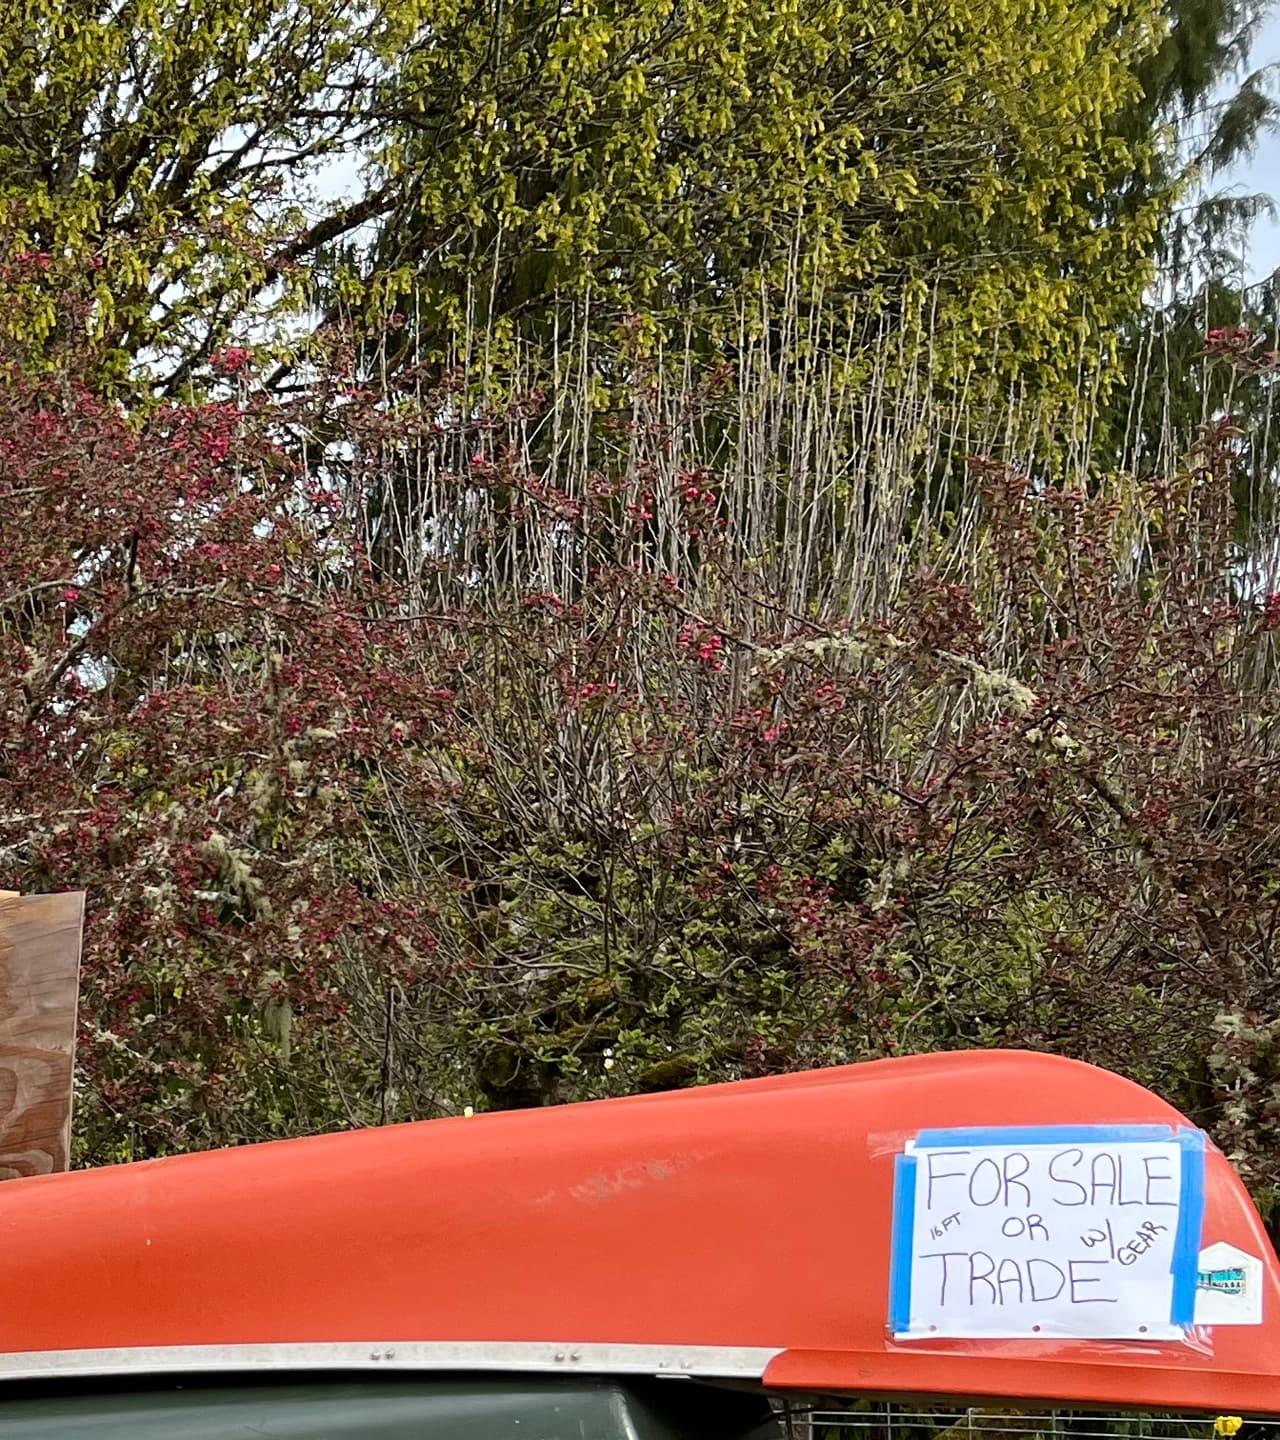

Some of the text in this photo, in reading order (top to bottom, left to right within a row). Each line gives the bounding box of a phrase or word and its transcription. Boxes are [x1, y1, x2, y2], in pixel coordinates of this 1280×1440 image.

[928, 1149, 1178, 1210] FOR SALE
[1001, 1213, 1050, 1241] OR
[1117, 1220, 1168, 1266] GEAR
[919, 1251, 1118, 1306] TRADE
